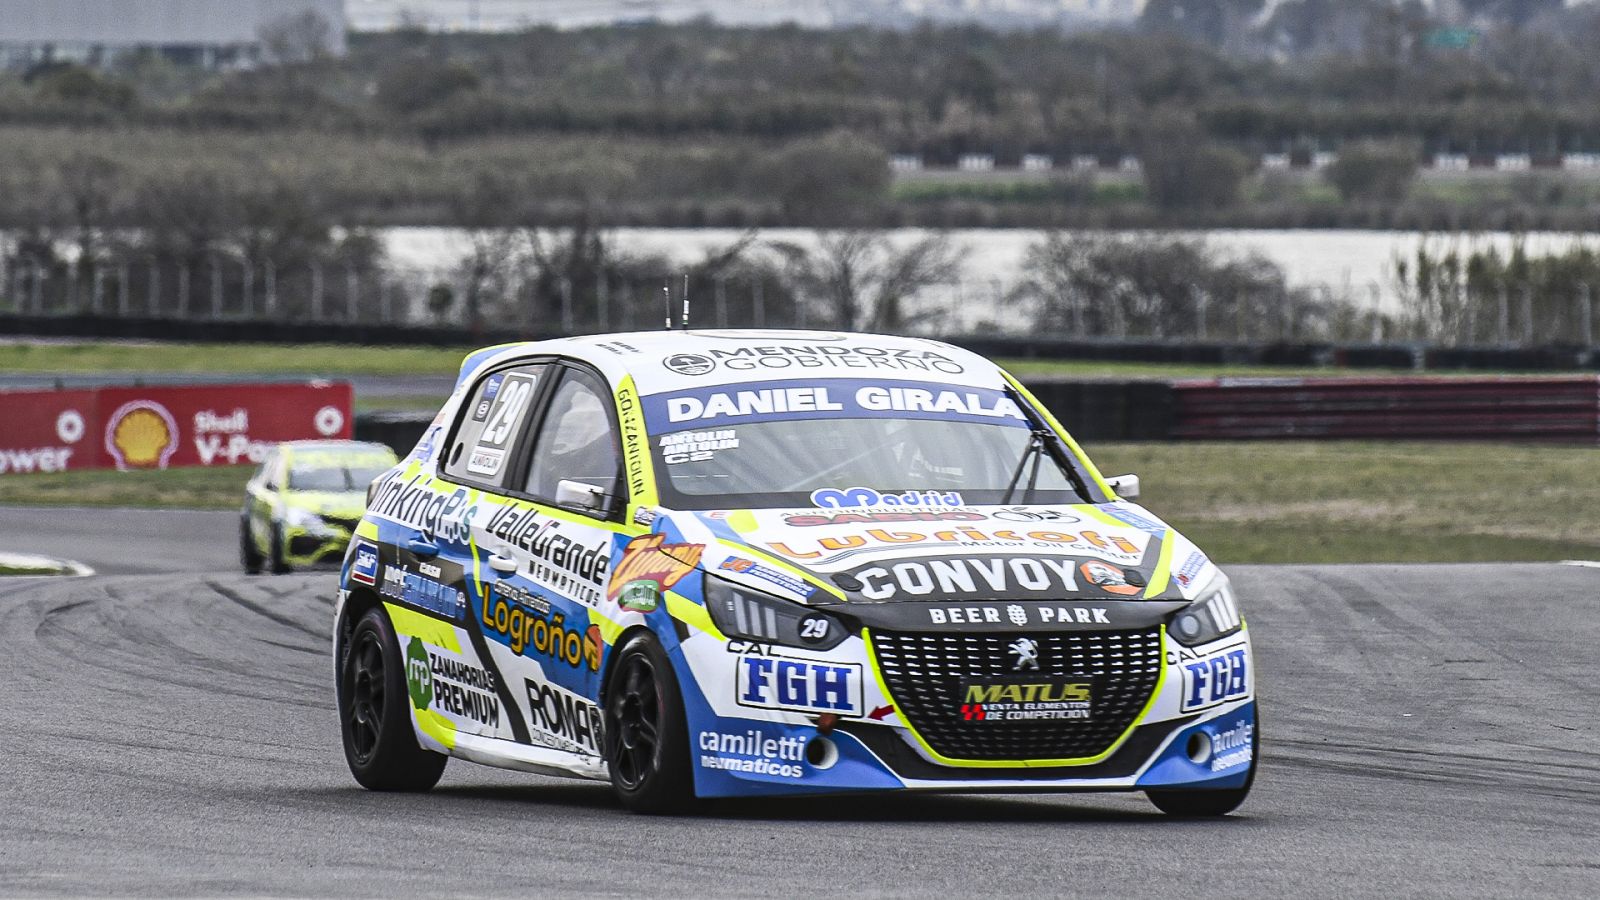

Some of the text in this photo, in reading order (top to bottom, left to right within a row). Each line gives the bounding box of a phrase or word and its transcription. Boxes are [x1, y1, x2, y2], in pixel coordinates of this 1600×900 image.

[709, 345, 954, 362] MENDOZA
[724, 355, 965, 374] GOBIERNO
[480, 380, 531, 445] 29
[667, 385, 1028, 423] DANIEL GIRALA
[194, 407, 249, 433] Shell
[665, 450, 714, 465] C2
[814, 488, 961, 508] Madrid
[959, 540, 1142, 561] Motor Oil Center
[854, 556, 1080, 600] CONVOY
[481, 583, 582, 666] Logroño
[928, 606, 1110, 624] BEER PARK
[800, 618, 830, 639] 29
[726, 640, 782, 657] CAL
[429, 652, 495, 694] ZANAHORIAS
[743, 657, 854, 711] FGH
[965, 683, 1092, 703] MATUS
[433, 678, 499, 729] PREMIUM
[982, 701, 1091, 711] VENTA ELEMENTOS
[985, 709, 1091, 720] DE COMPETICION
[699, 730, 806, 761] camiletti
[701, 755, 803, 778] neumaticos
